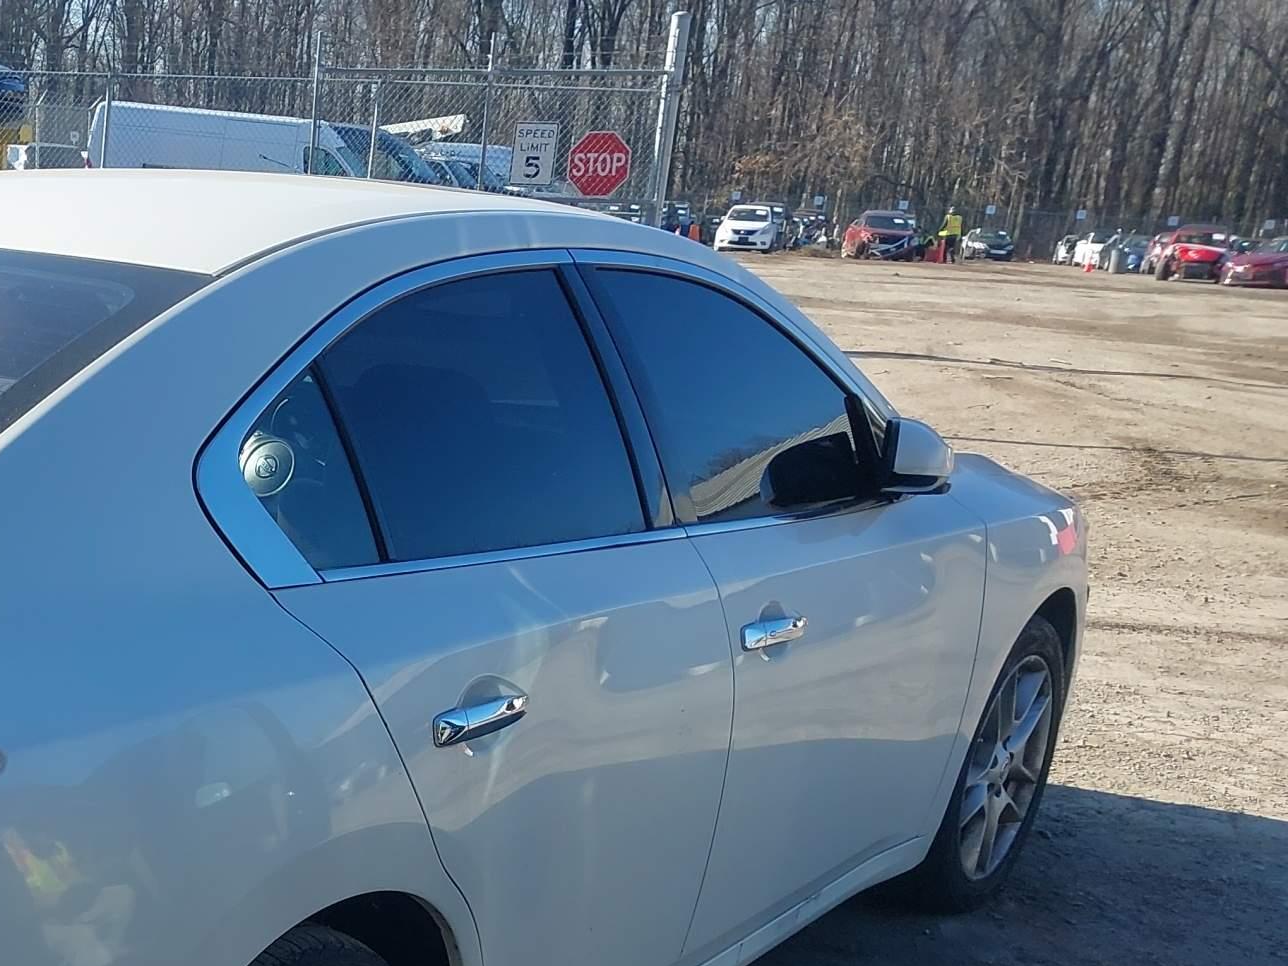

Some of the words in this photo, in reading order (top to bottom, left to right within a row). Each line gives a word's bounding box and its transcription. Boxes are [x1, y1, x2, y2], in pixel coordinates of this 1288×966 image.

[518, 129, 554, 139] SPEED
[520, 143, 549, 152] LIMIT
[524, 156, 540, 178] 5
[572, 152, 626, 177] STOP
